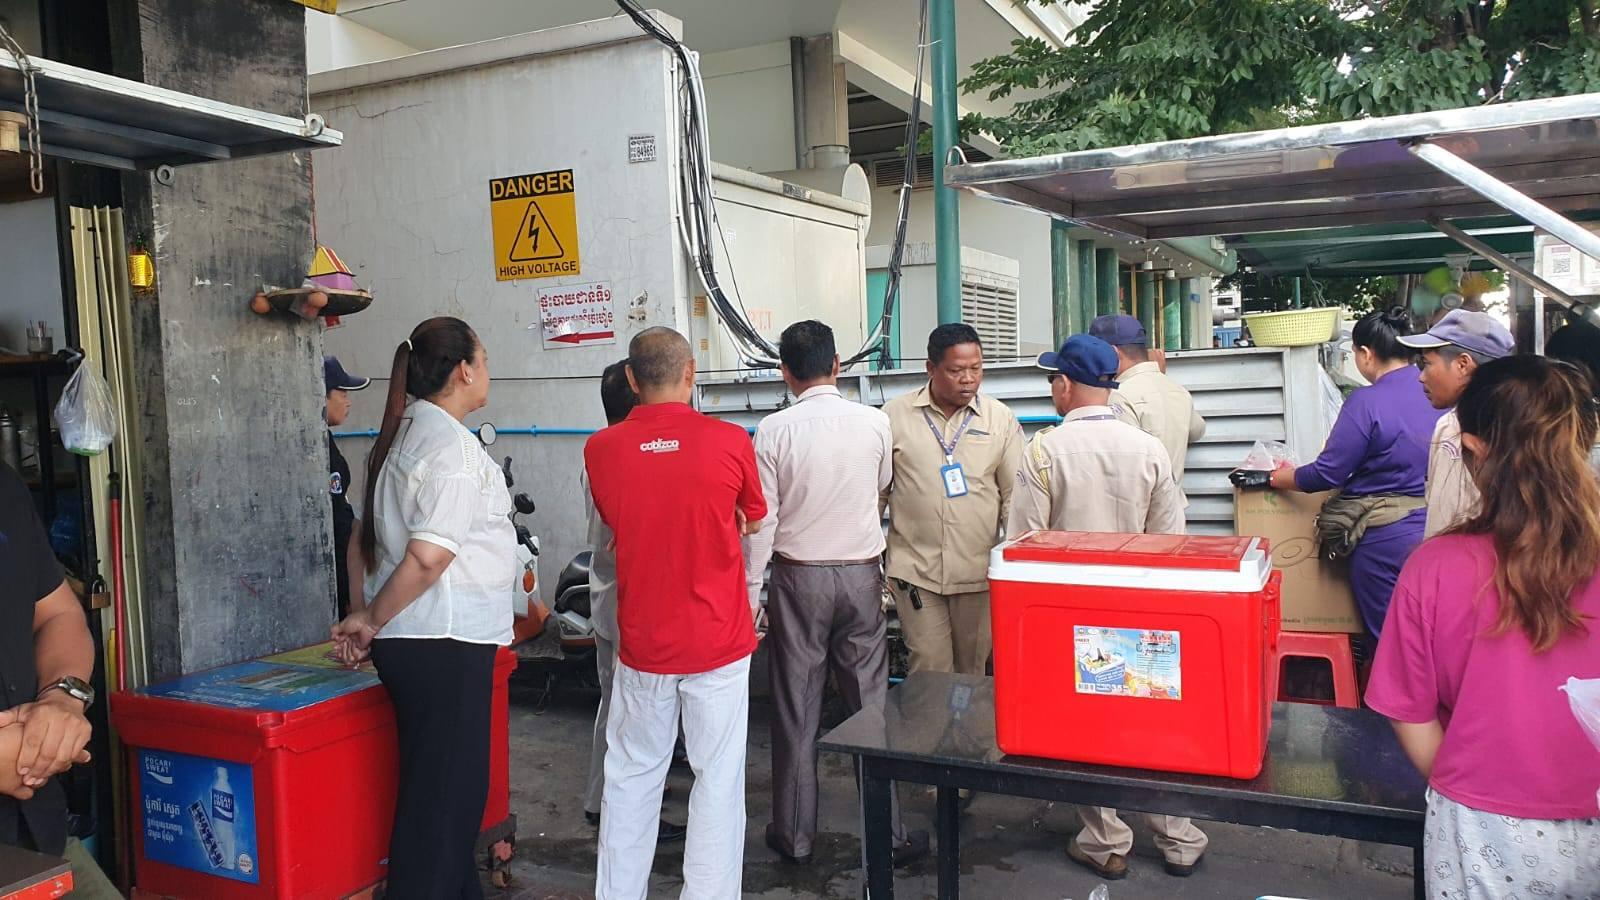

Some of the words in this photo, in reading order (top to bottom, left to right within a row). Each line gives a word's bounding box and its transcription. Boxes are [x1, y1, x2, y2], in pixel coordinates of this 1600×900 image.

[491, 171, 573, 199] DANGER
[499, 265, 525, 276] HIGH
[527, 260, 577, 274] VOLTAGE
[145, 756, 171, 767] POCARI
[146, 763, 169, 774] SWEAT
